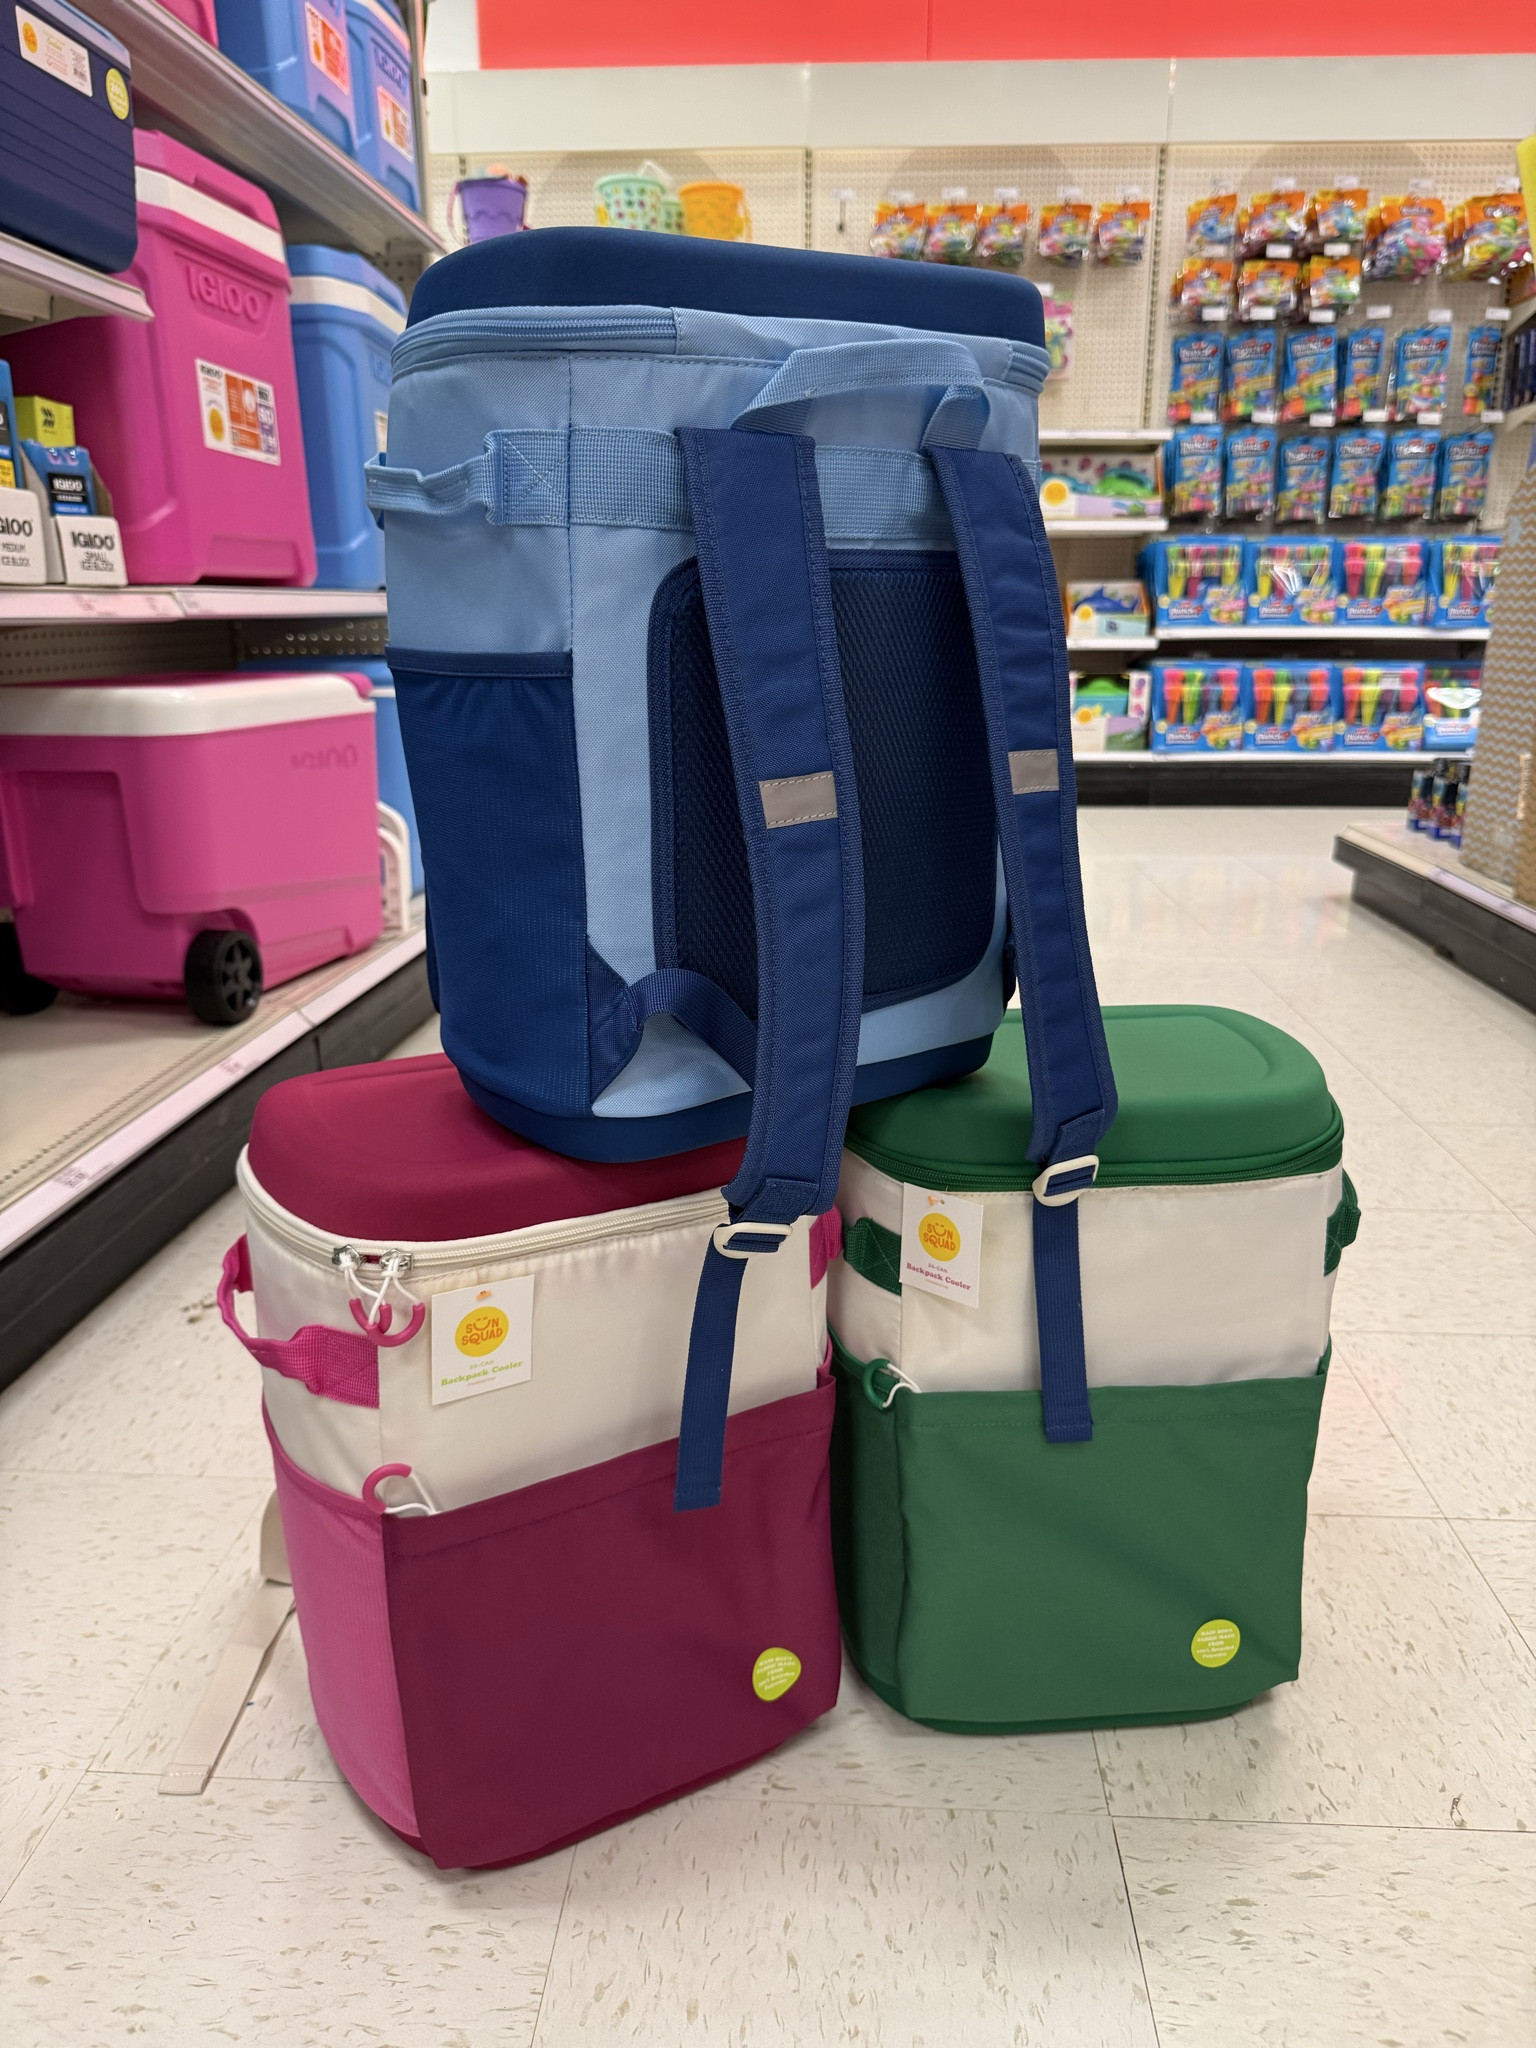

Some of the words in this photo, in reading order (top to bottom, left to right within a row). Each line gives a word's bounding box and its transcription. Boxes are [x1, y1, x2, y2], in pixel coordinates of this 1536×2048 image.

[186, 265, 261, 321] IGLOO
[0, 516, 33, 537] GLOO
[71, 531, 115, 551] IGLOO
[926, 1222, 953, 1240] SUN
[923, 1233, 956, 1251] SQUAD
[906, 1263, 943, 1281] Backpack
[945, 1276, 971, 1290] Cooler
[465, 1316, 500, 1334] SUN
[461, 1328, 503, 1346] SQUAD
[441, 1369, 489, 1386] Backpack
[492, 1361, 523, 1373] Cooler
